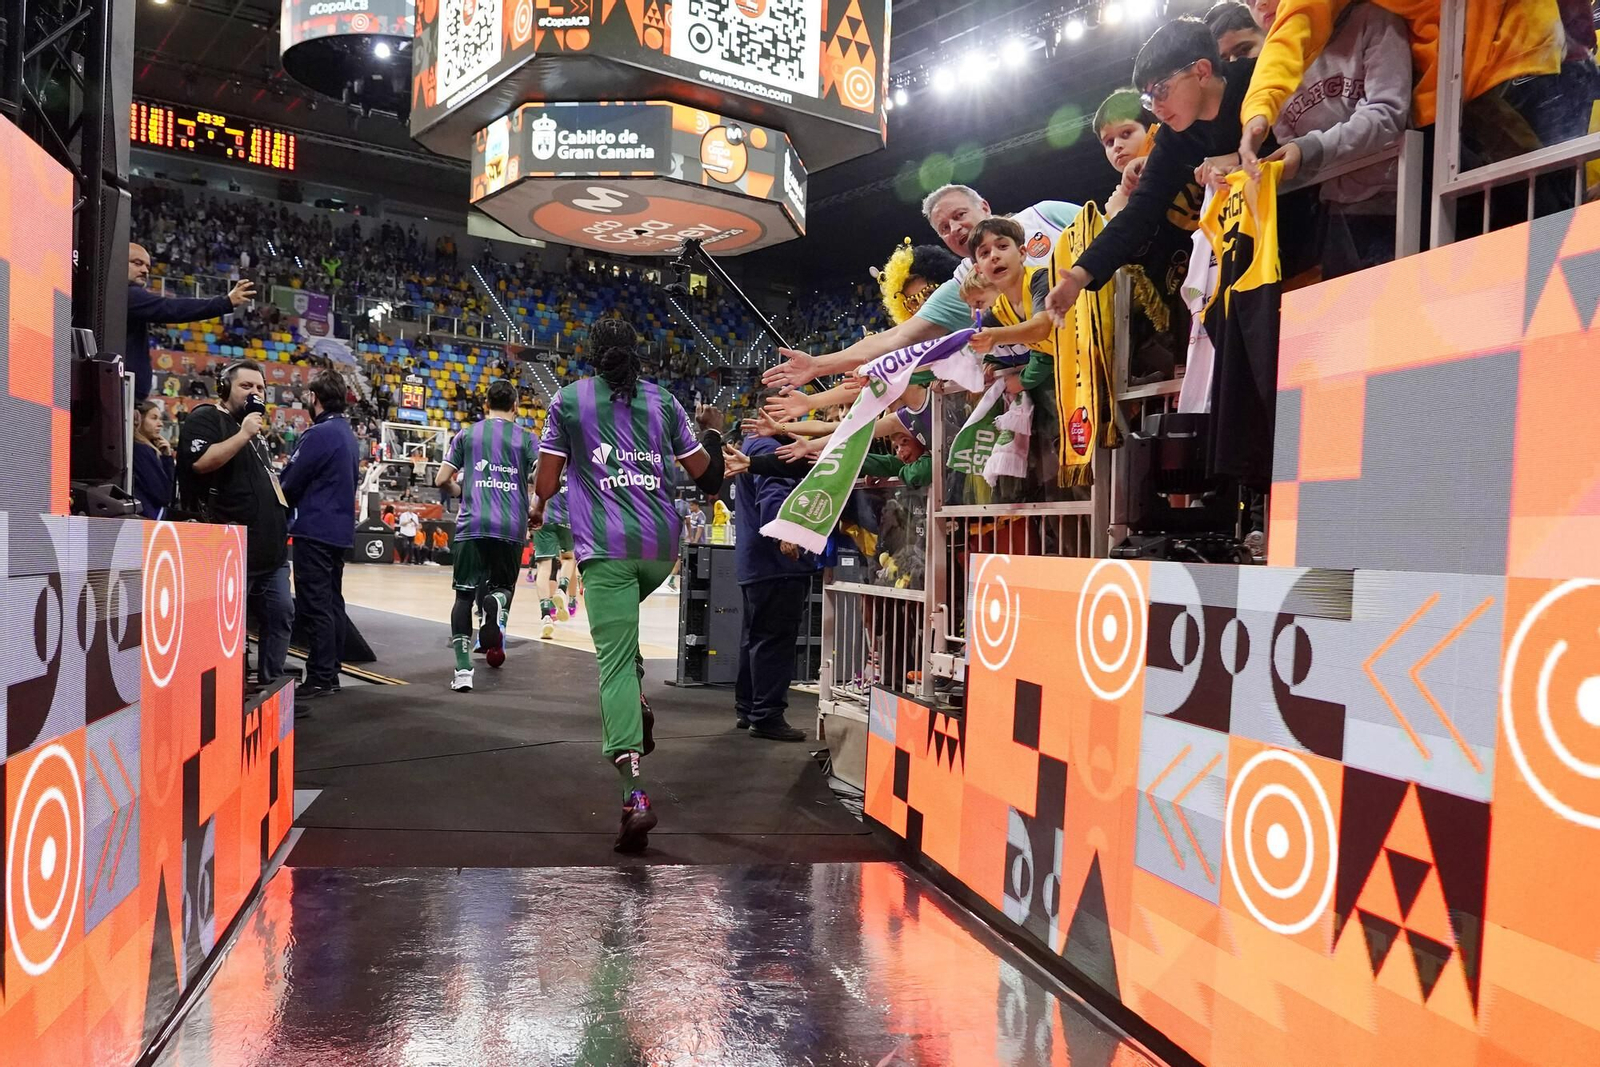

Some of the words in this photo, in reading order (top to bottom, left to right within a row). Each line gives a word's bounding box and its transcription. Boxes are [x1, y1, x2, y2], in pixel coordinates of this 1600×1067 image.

[309, 0, 369, 15] #CopaACB
[538, 16, 590, 28] #CopaACB
[699, 69, 792, 104] eventos.acb.com
[557, 129, 616, 145] Cabildo
[618, 129, 639, 144] de
[557, 145, 595, 159] Gran
[596, 144, 655, 159] Canaria
[582, 220, 623, 234] acb
[594, 220, 673, 243] Copa
[403, 393, 420, 407] 24
[615, 449, 661, 465] Unicaja
[489, 464, 518, 475] Unicaja
